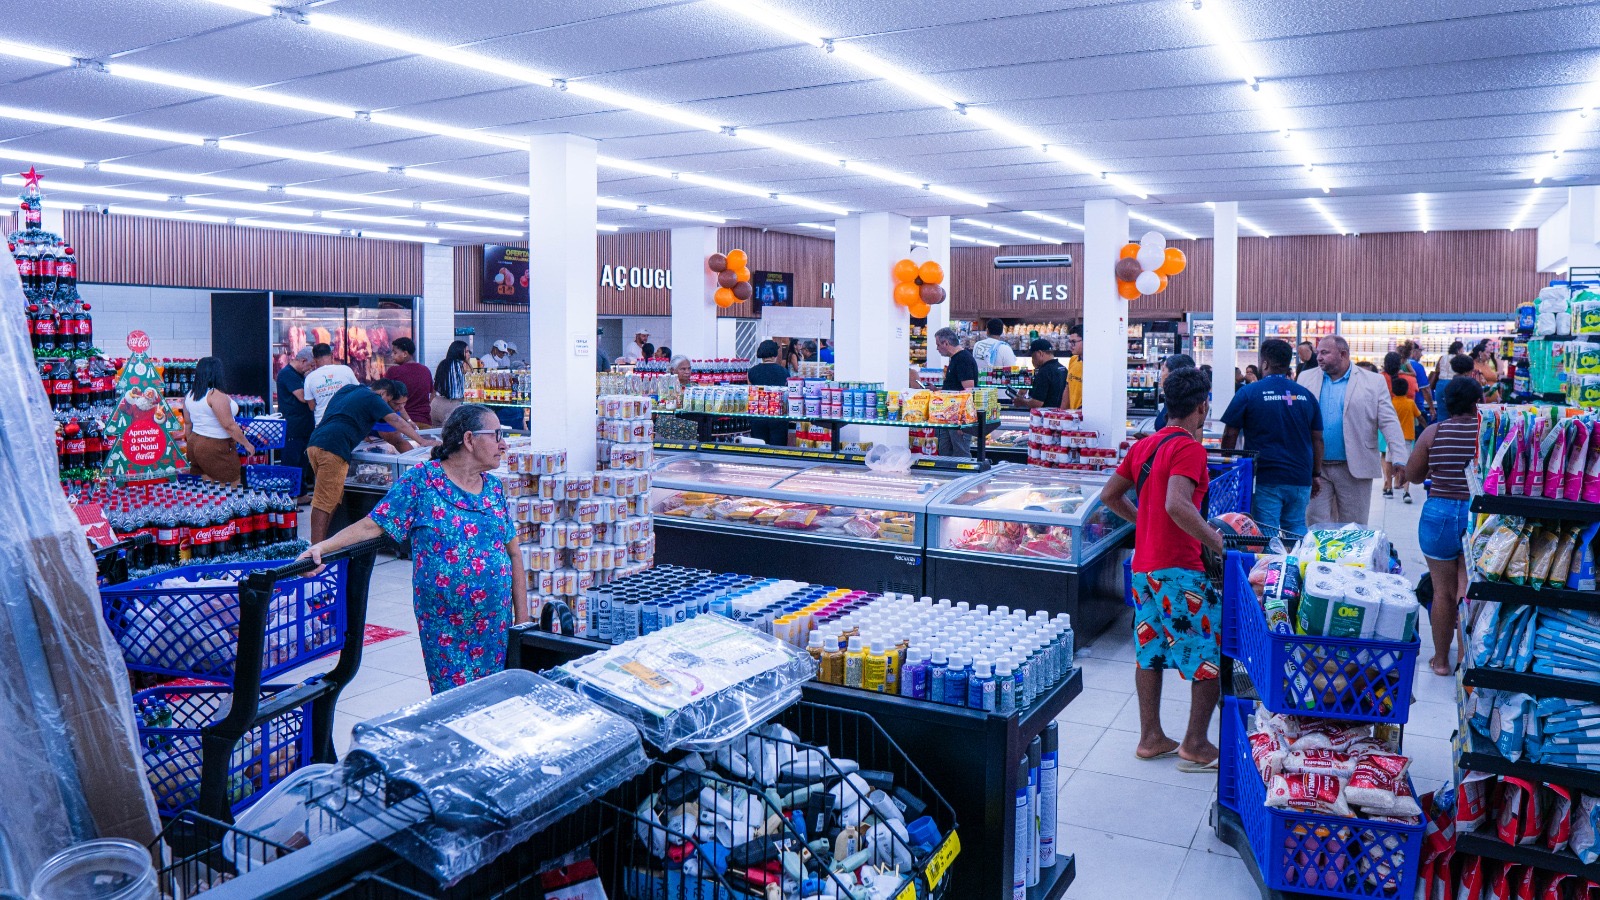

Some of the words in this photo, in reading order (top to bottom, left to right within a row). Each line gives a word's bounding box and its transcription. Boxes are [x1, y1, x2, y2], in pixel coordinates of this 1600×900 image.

[1012, 280, 1068, 301] PÃES
[129, 428, 159, 437] Aproveite
[140, 443, 159, 451] Natal
